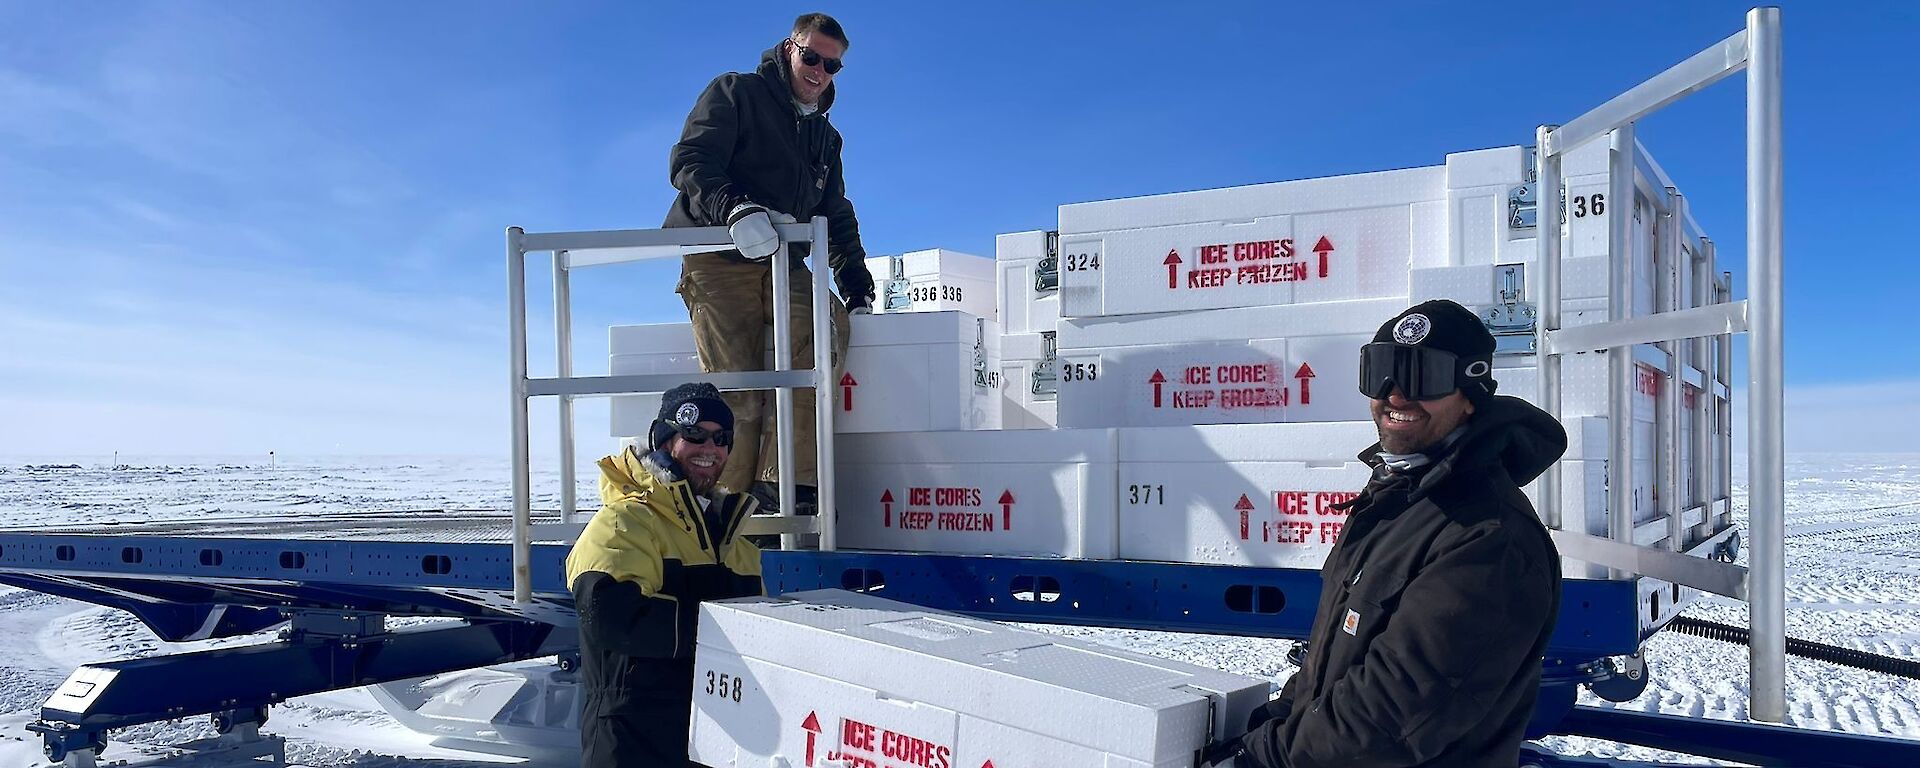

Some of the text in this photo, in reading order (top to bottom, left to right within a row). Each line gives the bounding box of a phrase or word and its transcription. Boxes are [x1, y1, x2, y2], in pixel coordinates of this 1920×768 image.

[1573, 193, 1605, 218] 36
[1067, 252, 1100, 272] 324
[1200, 239, 1295, 265] ICE CORES
[1188, 262, 1307, 289] KEEP FROZEN
[913, 287, 937, 302] 336
[942, 284, 962, 302] 336
[1063, 363, 1097, 382] 353
[1184, 364, 1268, 385] ICE CORE
[1173, 389, 1214, 409] KEEP
[909, 487, 982, 507] ICE CORES
[1129, 484, 1163, 505] 371
[1277, 491, 1308, 516] ICE
[900, 511, 993, 532] KEEP FROZEN
[706, 670, 742, 703] 358
[843, 718, 876, 753] ICE
[881, 730, 951, 768] CORES
